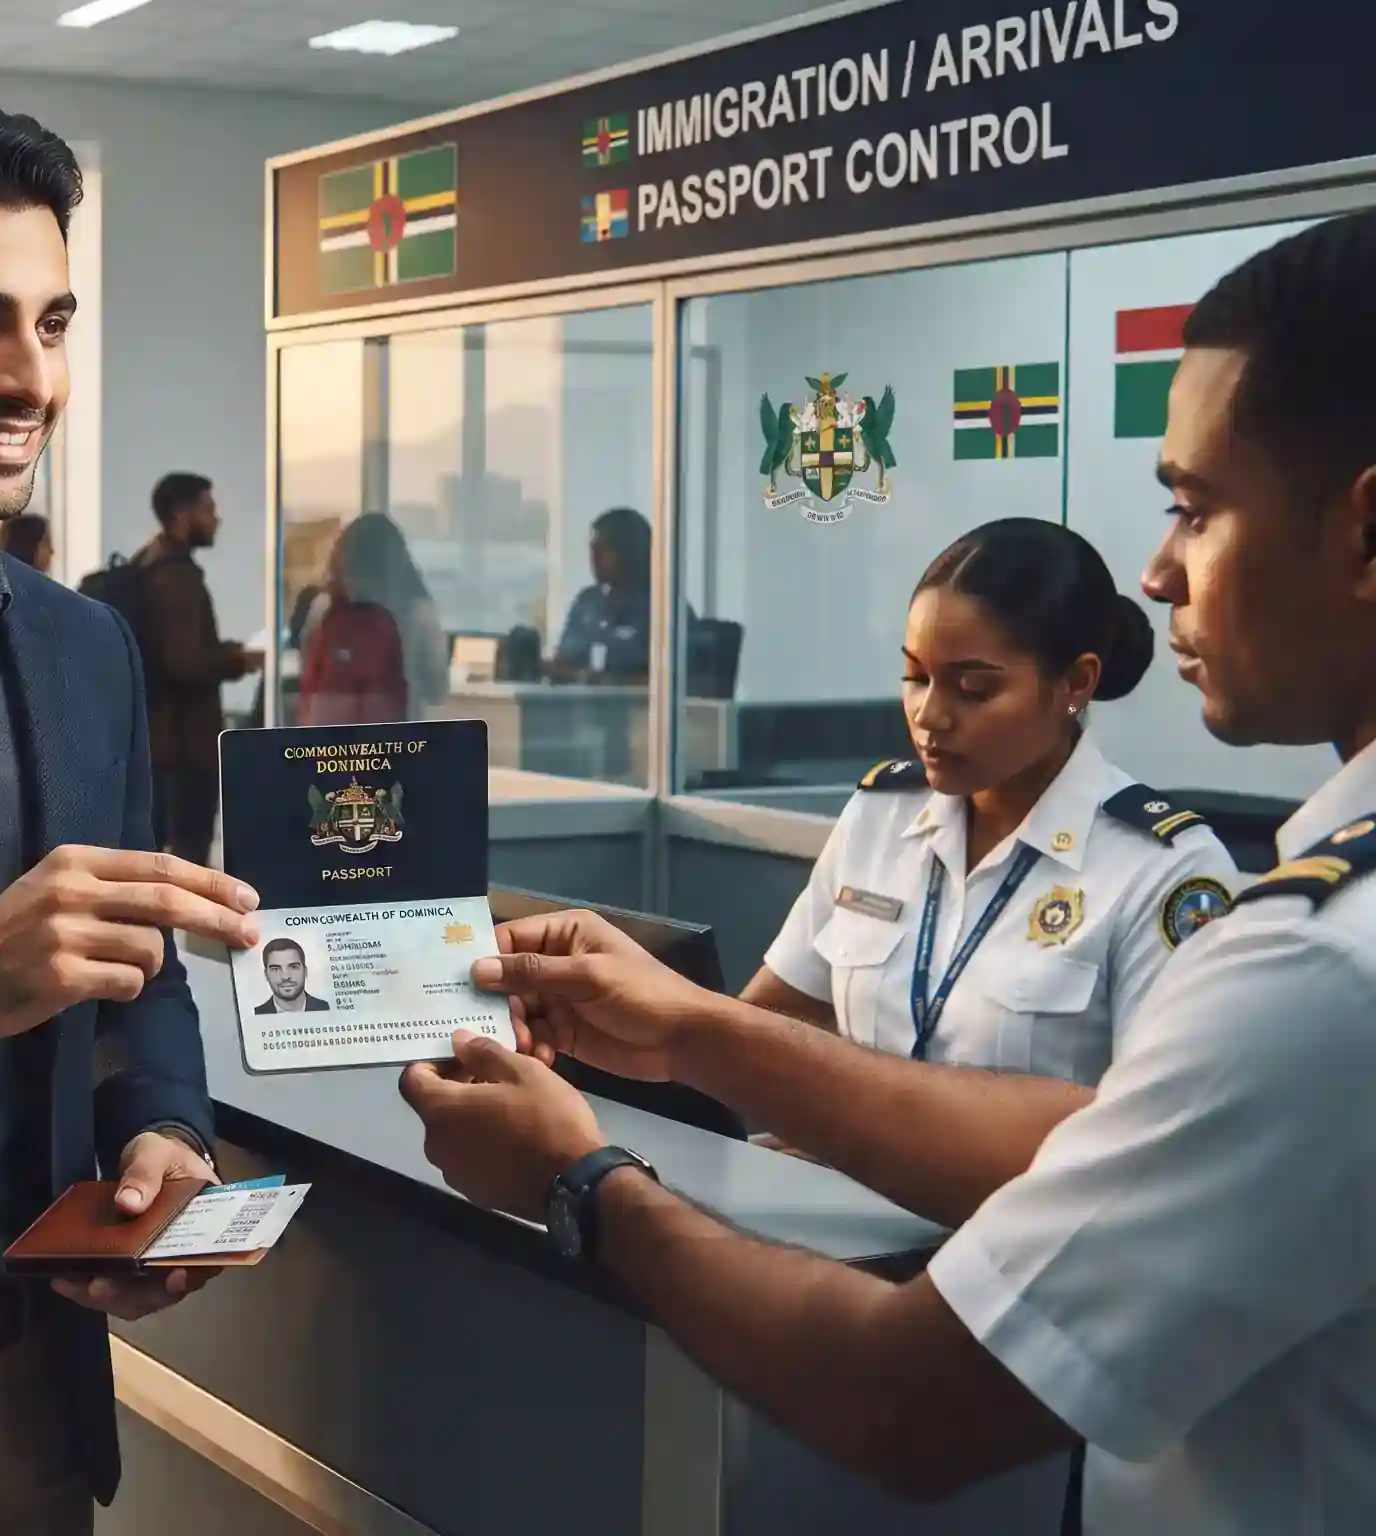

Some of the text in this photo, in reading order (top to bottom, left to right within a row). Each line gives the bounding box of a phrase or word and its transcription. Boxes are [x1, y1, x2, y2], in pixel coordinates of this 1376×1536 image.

[637, 48, 890, 157] IMMIGRATION
[925, 0, 1180, 92] ARRIVALS
[638, 103, 1069, 233] PASSPORT CONTROL
[407, 741, 427, 753] OF
[322, 867, 393, 881] PASSPORT
[382, 911, 396, 920] OF
[400, 907, 453, 918] DOMINICA
